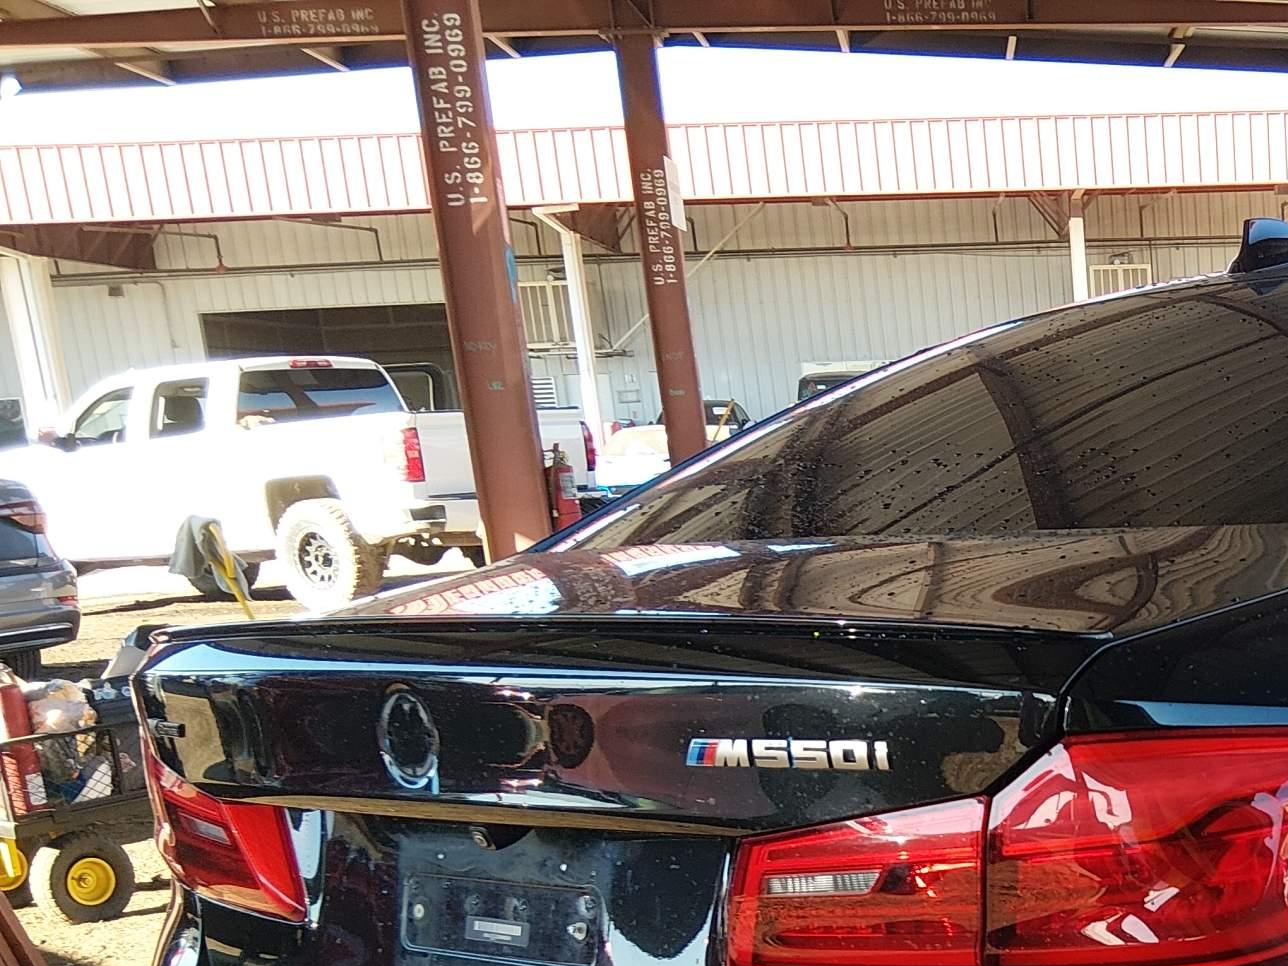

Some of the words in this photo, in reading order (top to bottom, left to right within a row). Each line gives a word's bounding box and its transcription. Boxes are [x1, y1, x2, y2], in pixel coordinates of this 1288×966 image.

[290, 8, 345, 23] PREFAB
[421, 12, 444, 54] INC.
[428, 66, 459, 153] PREFAB
[442, 12, 489, 204] 1-866-799-0969
[444, 164, 466, 206] U.S.
[643, 200, 662, 253] PREFAB
[653, 168, 679, 284] 1-866-799-0969
[651, 259, 665, 286] U.S.
